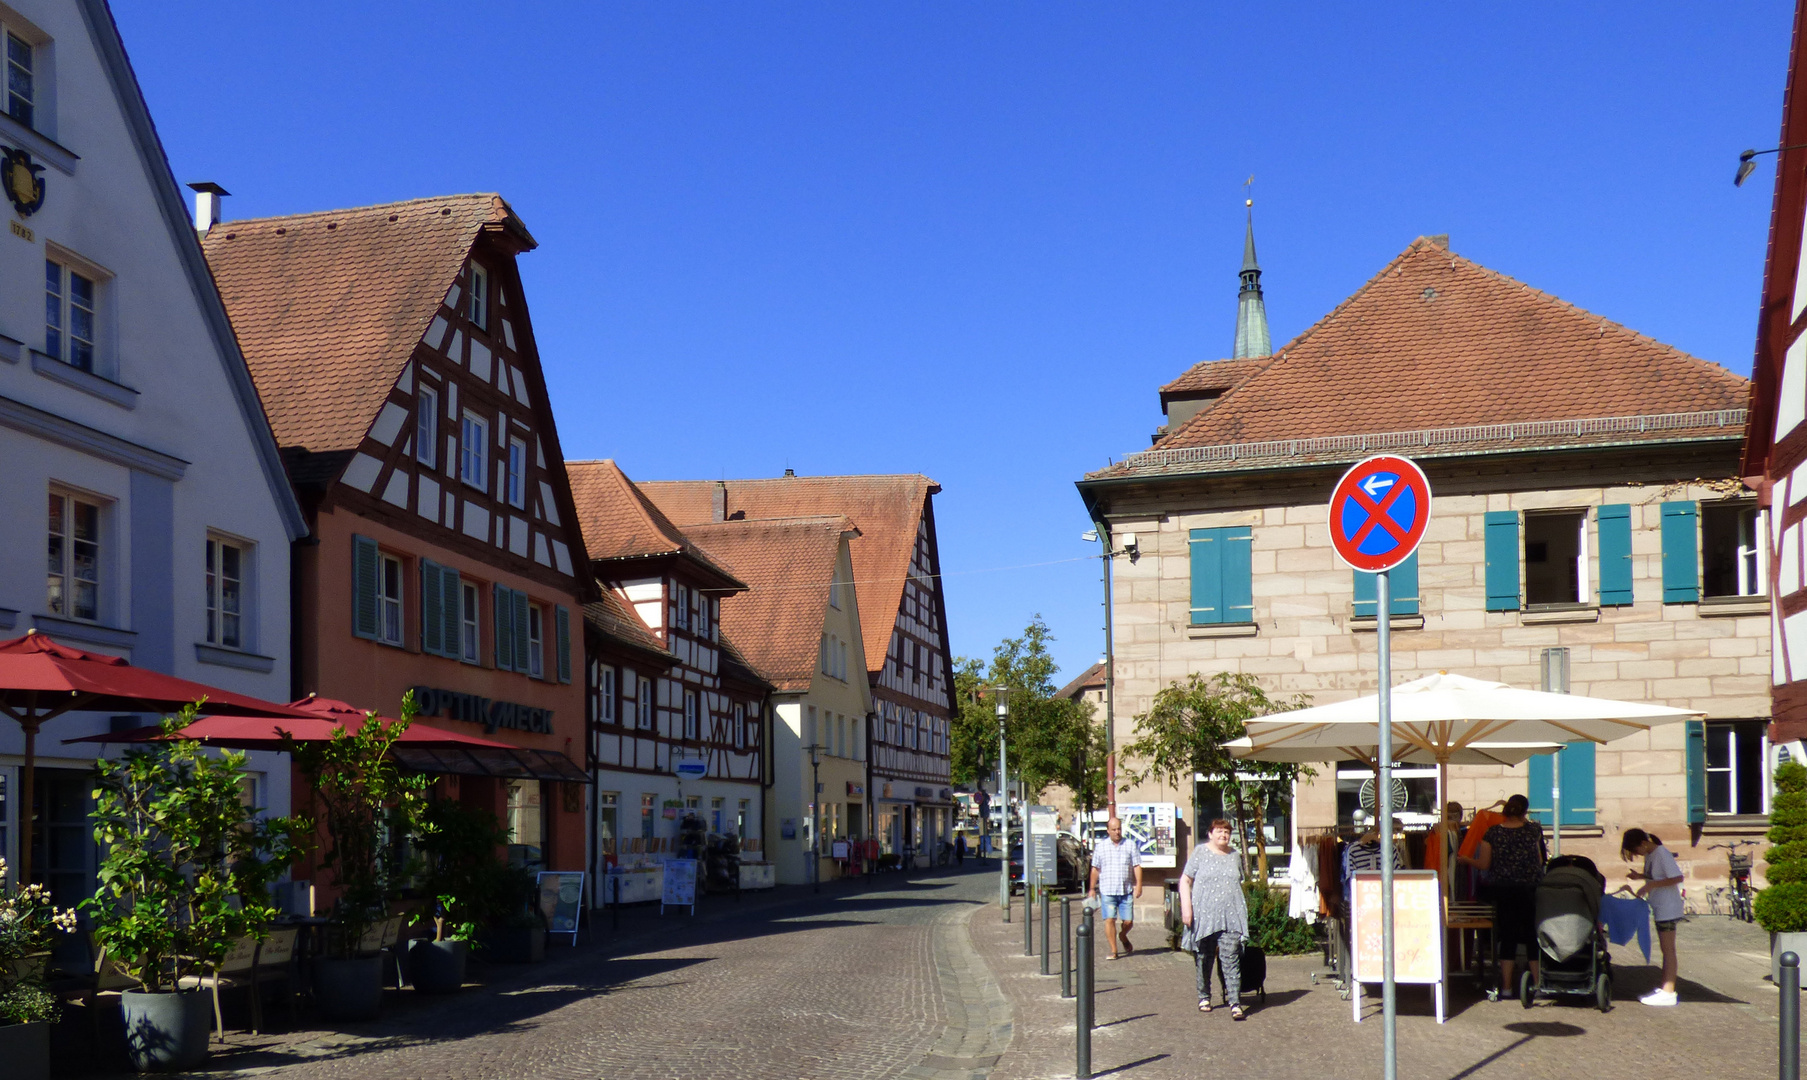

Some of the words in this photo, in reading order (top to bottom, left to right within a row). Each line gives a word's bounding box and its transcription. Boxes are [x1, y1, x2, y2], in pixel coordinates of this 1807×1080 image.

[414, 685, 493, 725] OPTIK
[484, 700, 556, 735] MECK
[1362, 882, 1428, 894] SOMER
[1362, 893, 1431, 911] SLE
